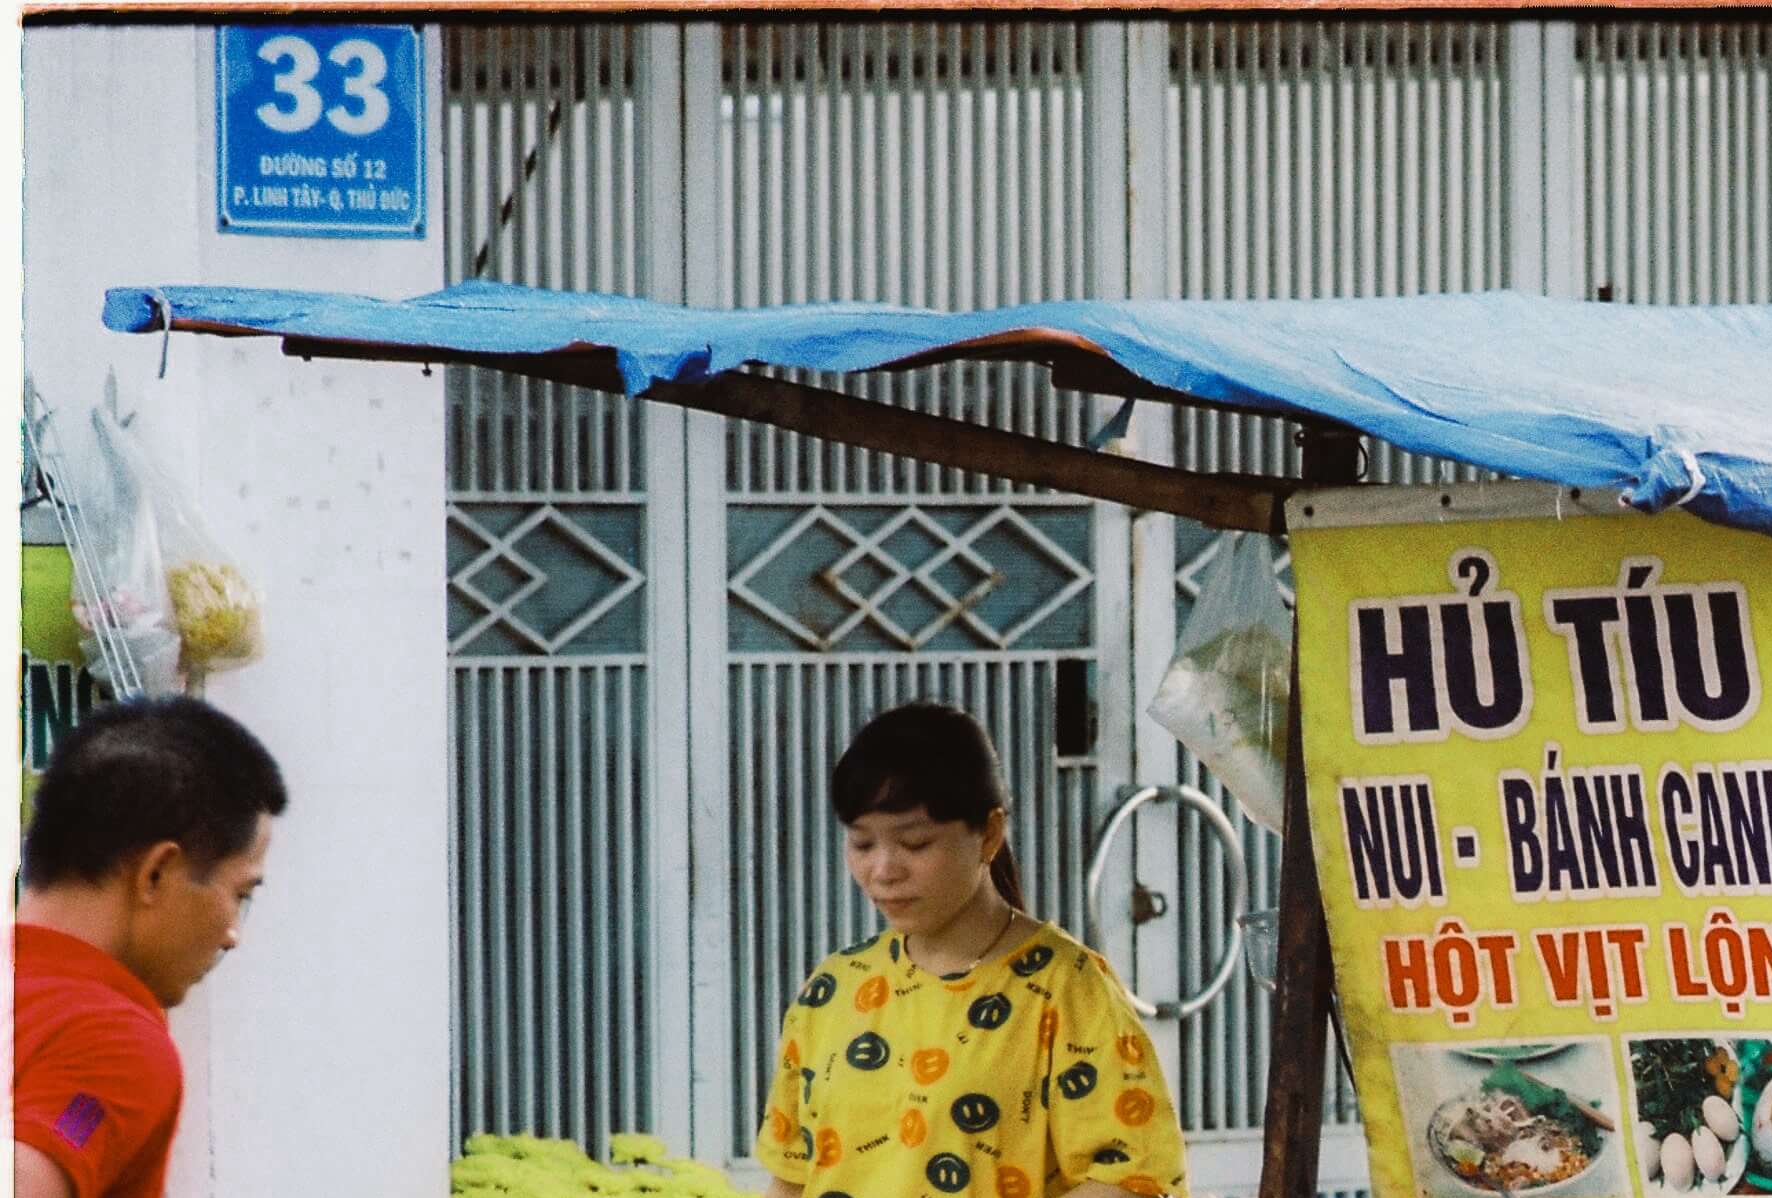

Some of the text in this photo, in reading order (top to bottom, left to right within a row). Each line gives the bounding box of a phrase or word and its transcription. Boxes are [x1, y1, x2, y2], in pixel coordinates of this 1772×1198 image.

[256, 35, 391, 134] 33
[233, 186, 250, 206] P.
[253, 186, 289, 207] LINH
[331, 153, 358, 178] SỐ
[363, 160, 387, 179] 12
[1358, 557, 1751, 733] HỦ TÍU
[1343, 784, 1443, 900] NUI
[1503, 751, 1657, 892] BÁNH
[1385, 922, 1516, 1023] HỘT
[1536, 929, 1644, 1016] VỊT
